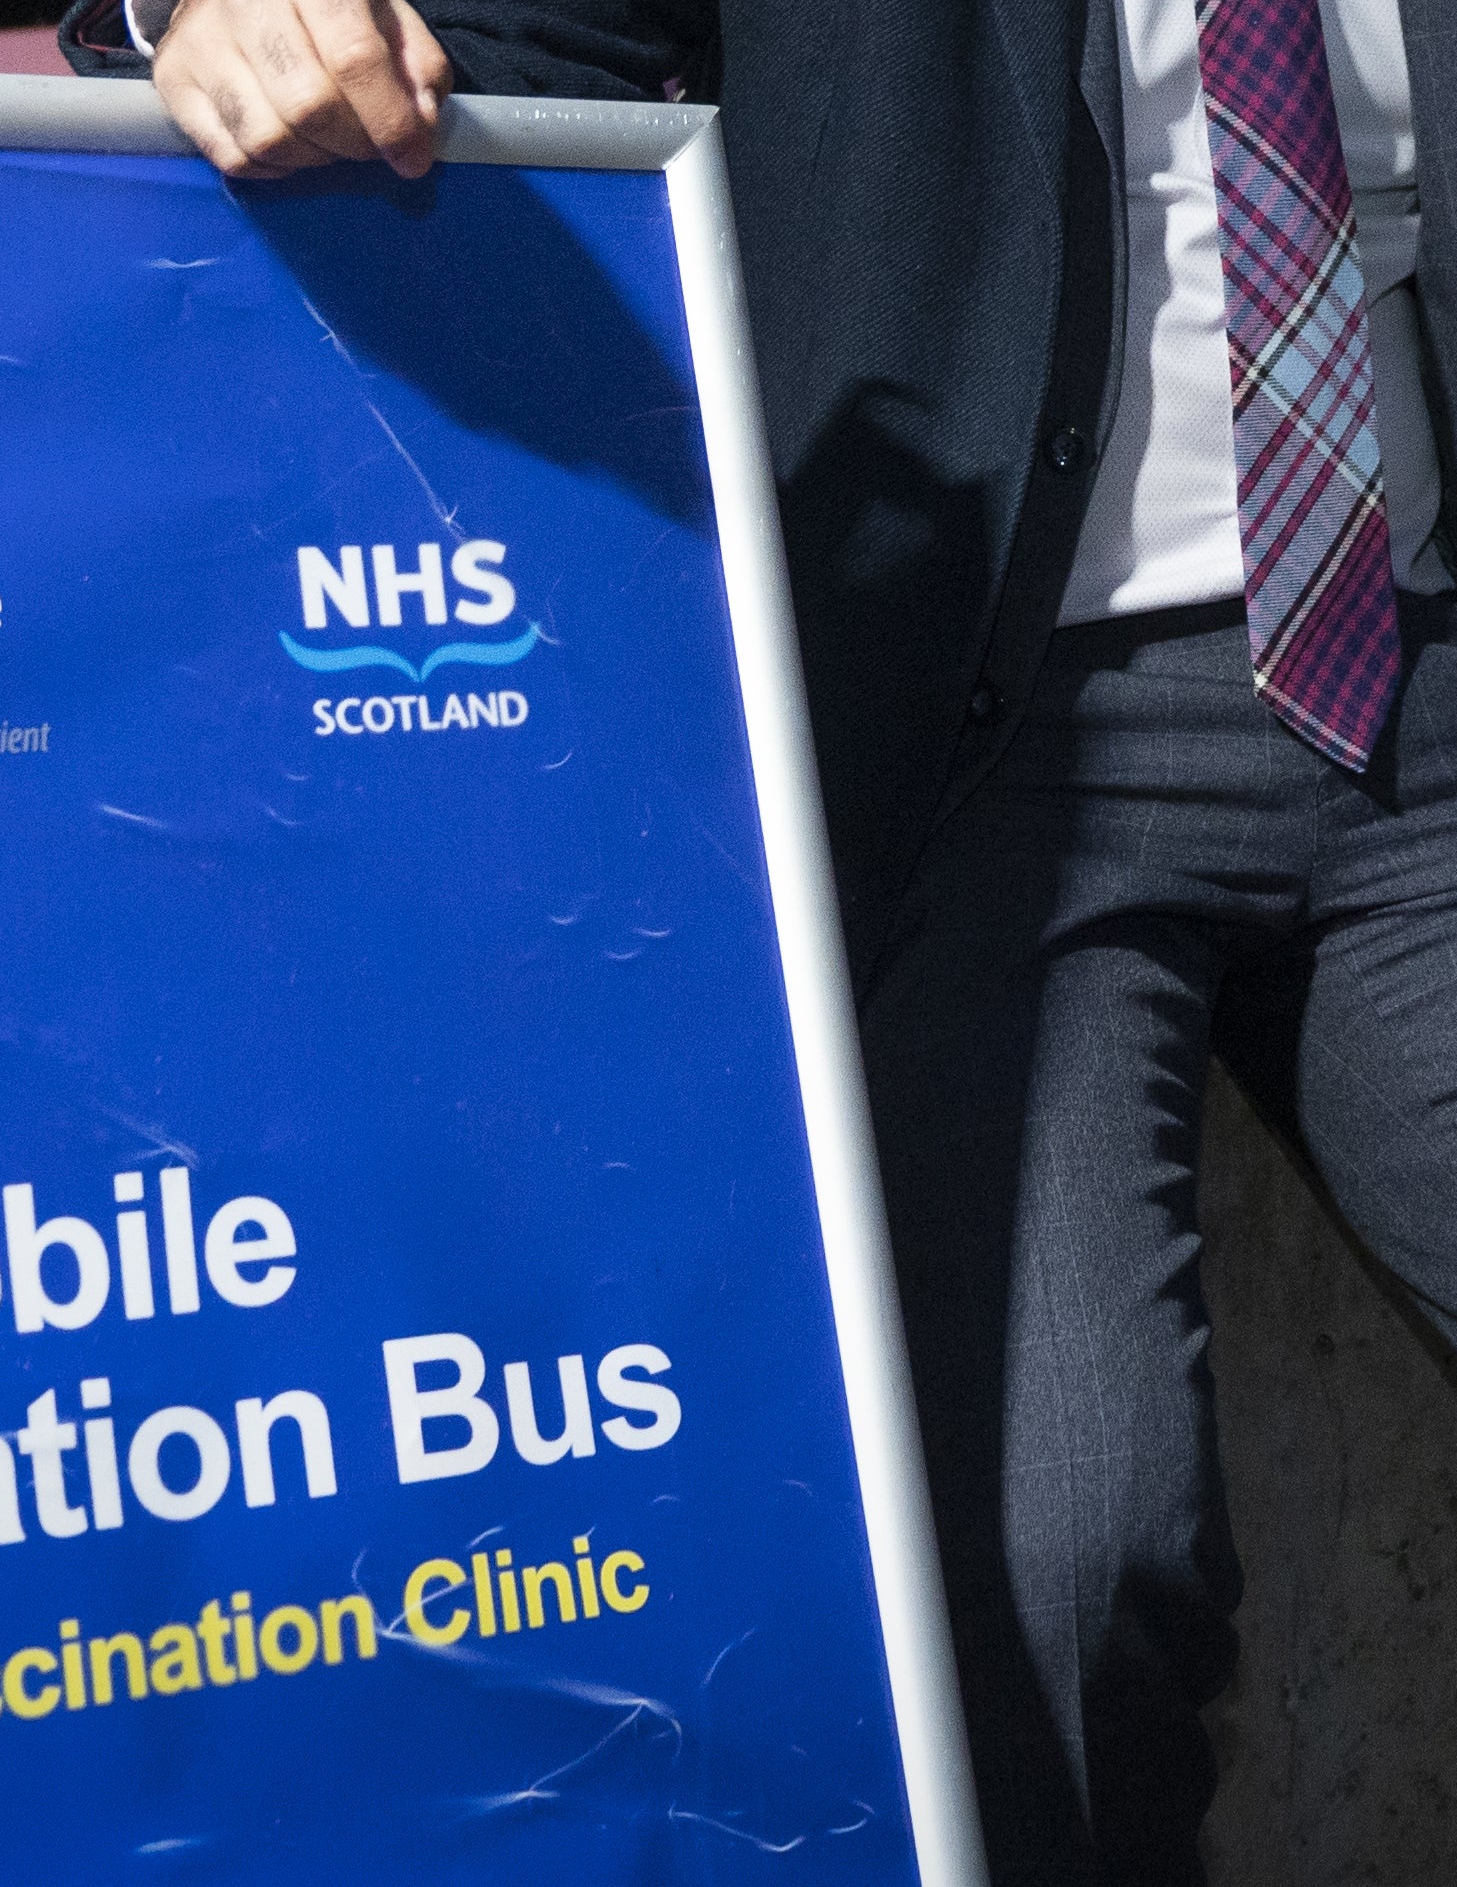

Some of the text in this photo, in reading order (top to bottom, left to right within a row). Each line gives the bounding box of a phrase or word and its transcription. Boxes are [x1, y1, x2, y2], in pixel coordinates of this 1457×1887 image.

[297, 539, 517, 630] NHS
[312, 690, 529, 736] SCOTLAND
[380, 1330, 684, 1486] Bus
[400, 1537, 653, 1649] Clinic
